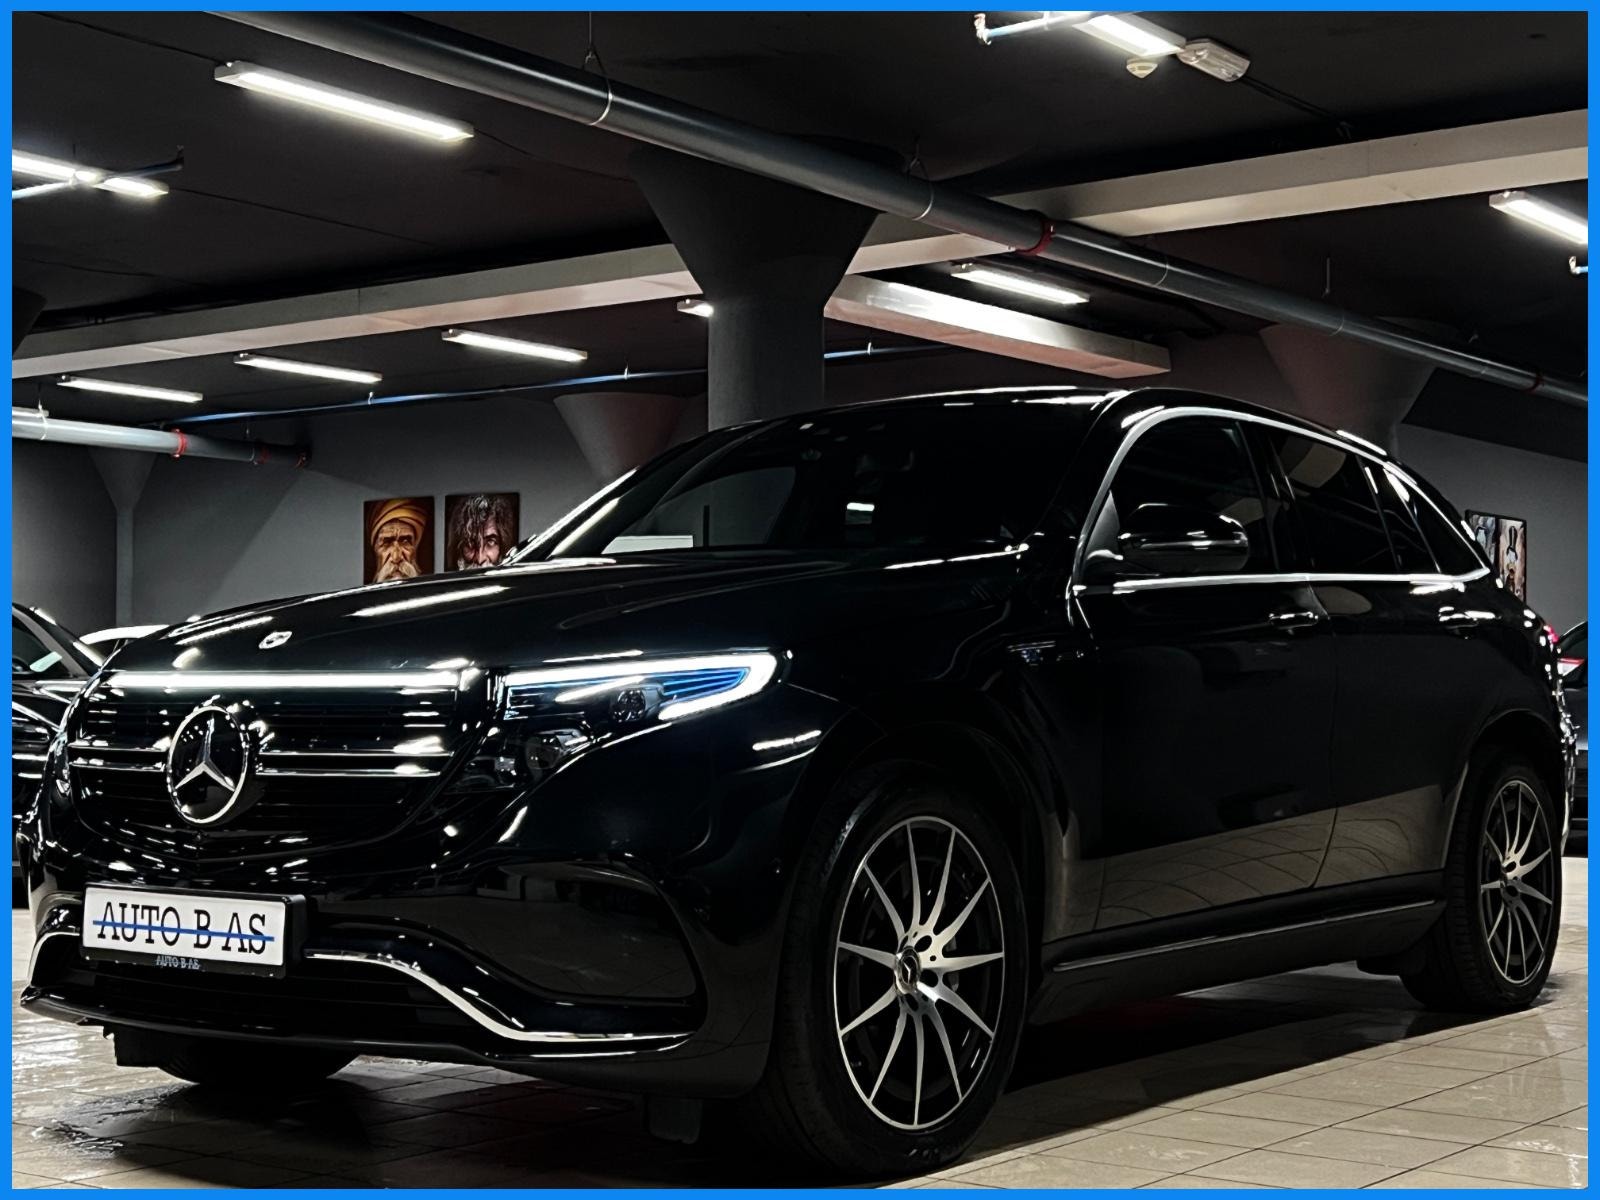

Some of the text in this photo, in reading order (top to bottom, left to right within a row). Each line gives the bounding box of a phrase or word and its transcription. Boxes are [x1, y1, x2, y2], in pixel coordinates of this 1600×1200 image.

[97, 901, 181, 947] AUTO
[222, 912, 266, 955] AS
[156, 954, 179, 968] AUTO
